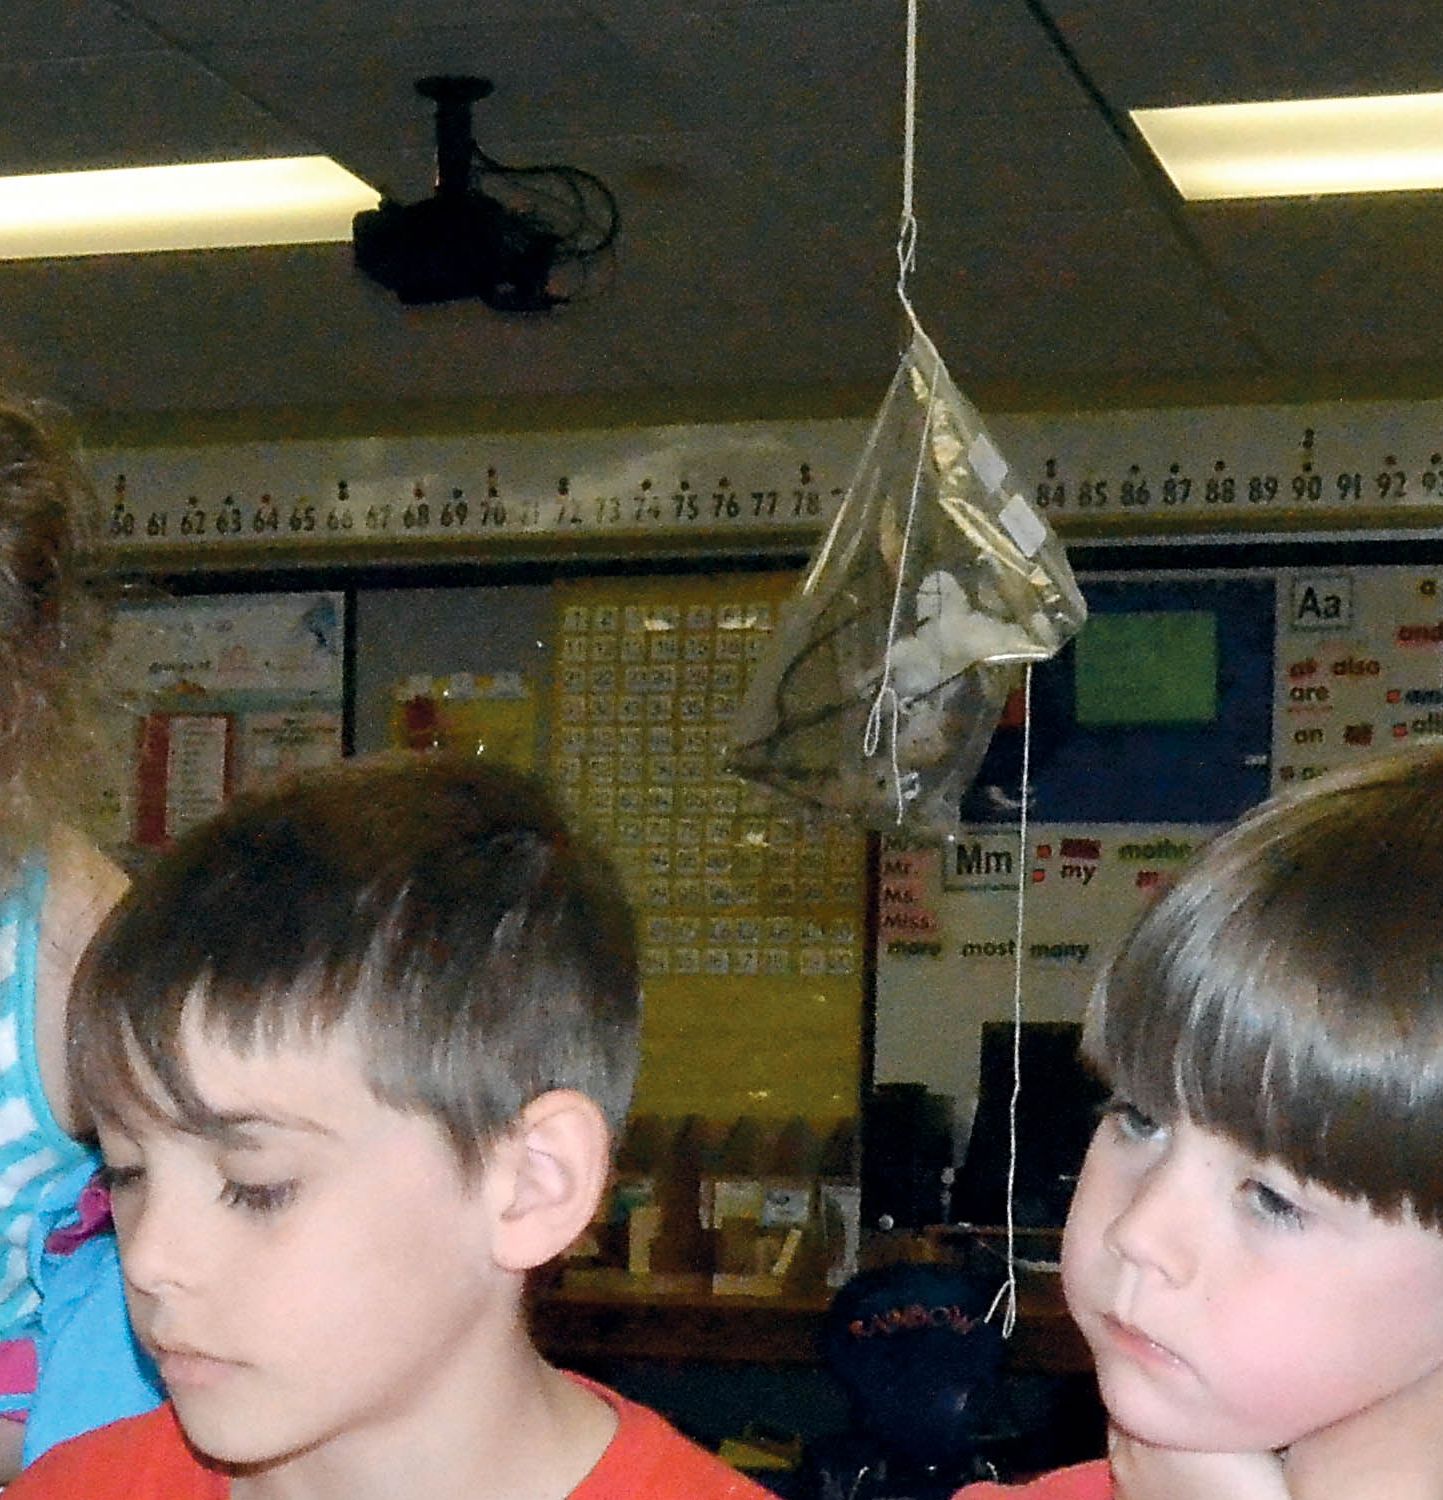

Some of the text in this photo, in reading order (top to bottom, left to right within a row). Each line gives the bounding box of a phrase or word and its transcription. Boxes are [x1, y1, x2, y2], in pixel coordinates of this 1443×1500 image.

[1035, 482, 1066, 508] 84
[1077, 481, 1108, 506] 85
[1120, 480, 1151, 505] 86
[1162, 477, 1191, 505] 87
[1204, 476, 1236, 504] 88
[1248, 475, 1278, 504] 89
[1291, 474, 1322, 501] 90
[1337, 472, 1362, 500] 91
[1376, 471, 1406, 501] 92
[147, 512, 168, 537] 61
[180, 510, 207, 535] 62
[216, 508, 242, 534] 63
[253, 507, 279, 533] 64
[288, 505, 316, 533] 65
[326, 505, 353, 531] 66
[366, 504, 391, 529] 67
[402, 502, 430, 529] 68
[440, 501, 469, 528] 69
[480, 501, 507, 527] 70
[671, 493, 701, 521] 75
[712, 491, 740, 520] 76
[750, 489, 780, 519] 77
[791, 488, 822, 517] 78
[1420, 579, 1436, 596] a
[1297, 586, 1342, 619] Aa
[1331, 657, 1381, 675] also
[1290, 686, 1329, 702] are
[1294, 728, 1323, 744] an
[956, 843, 1012, 874] Mm
[1060, 864, 1097, 885] my
[961, 939, 1015, 957] most
[1029, 942, 1090, 963] many
